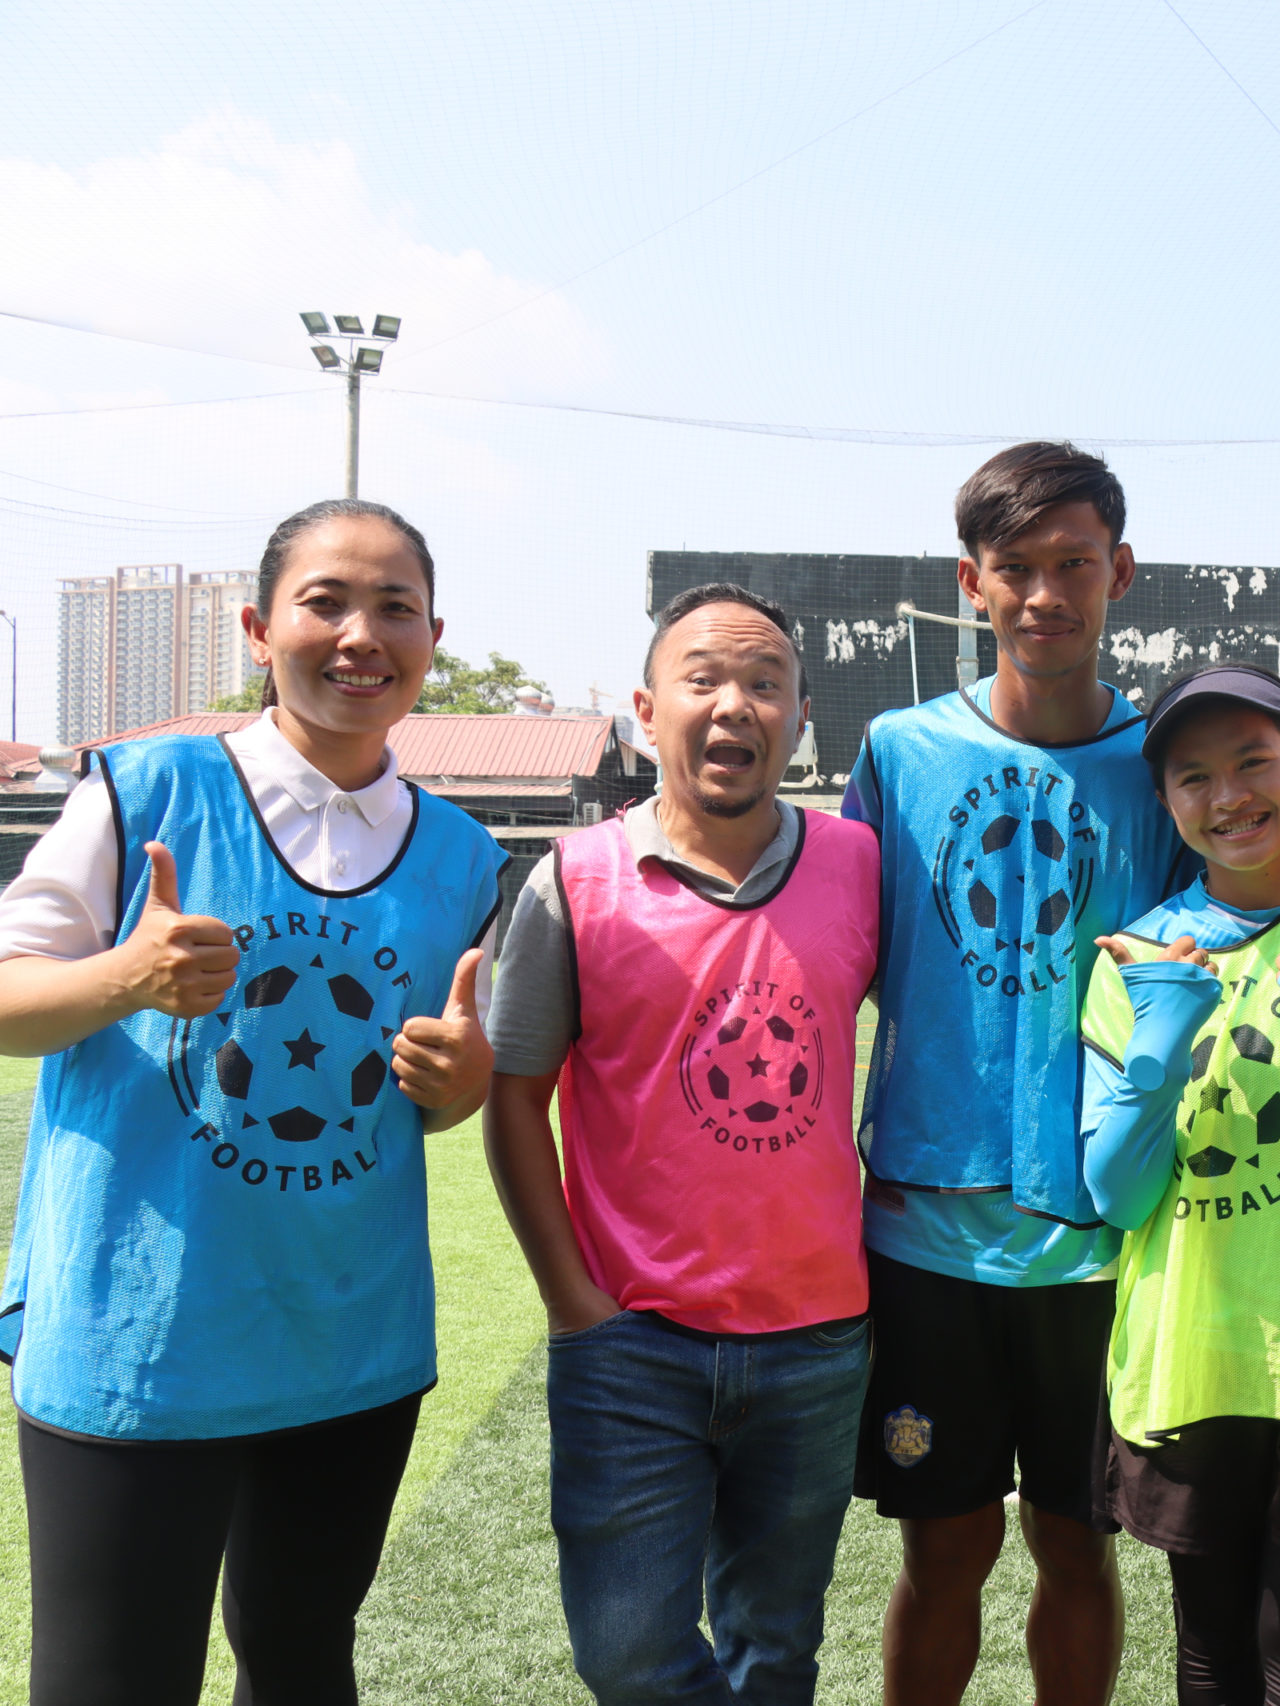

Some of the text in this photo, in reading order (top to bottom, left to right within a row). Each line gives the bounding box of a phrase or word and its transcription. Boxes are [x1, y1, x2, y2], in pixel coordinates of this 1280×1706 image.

[948, 766, 1095, 843] SPIRIT OF
[233, 911, 412, 991] PIRIT OF
[789, 995, 816, 1021] OF
[190, 1121, 377, 1192] FOOTBAL
[700, 1115, 817, 1154] FOOTBALL
